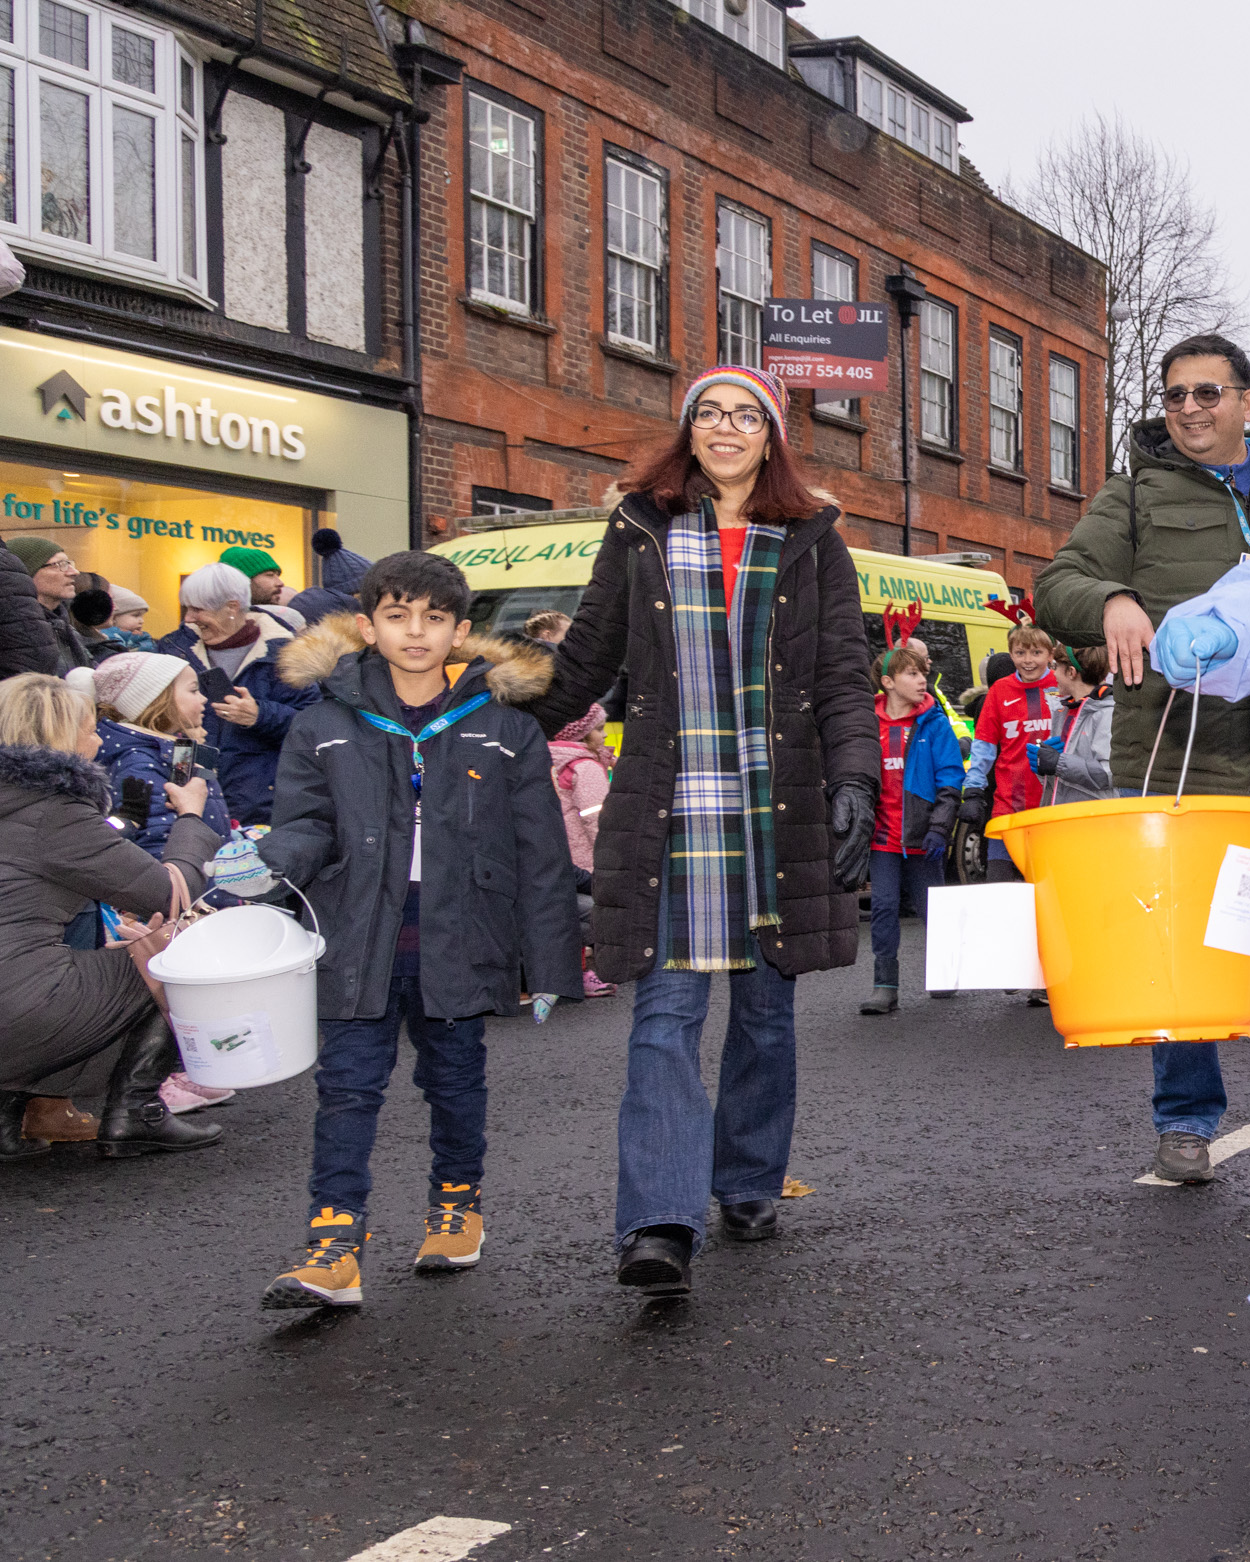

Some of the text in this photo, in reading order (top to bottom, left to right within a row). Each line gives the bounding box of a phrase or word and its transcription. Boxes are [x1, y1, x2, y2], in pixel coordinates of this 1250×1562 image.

[769, 304, 883, 325] To Let JLL
[769, 333, 831, 345] All Enquiries
[768, 363, 873, 380] 07887 554 405
[100, 385, 306, 461] ashtons
[3, 493, 275, 549] for life's great moves
[880, 575, 986, 611] AMBULANCE
